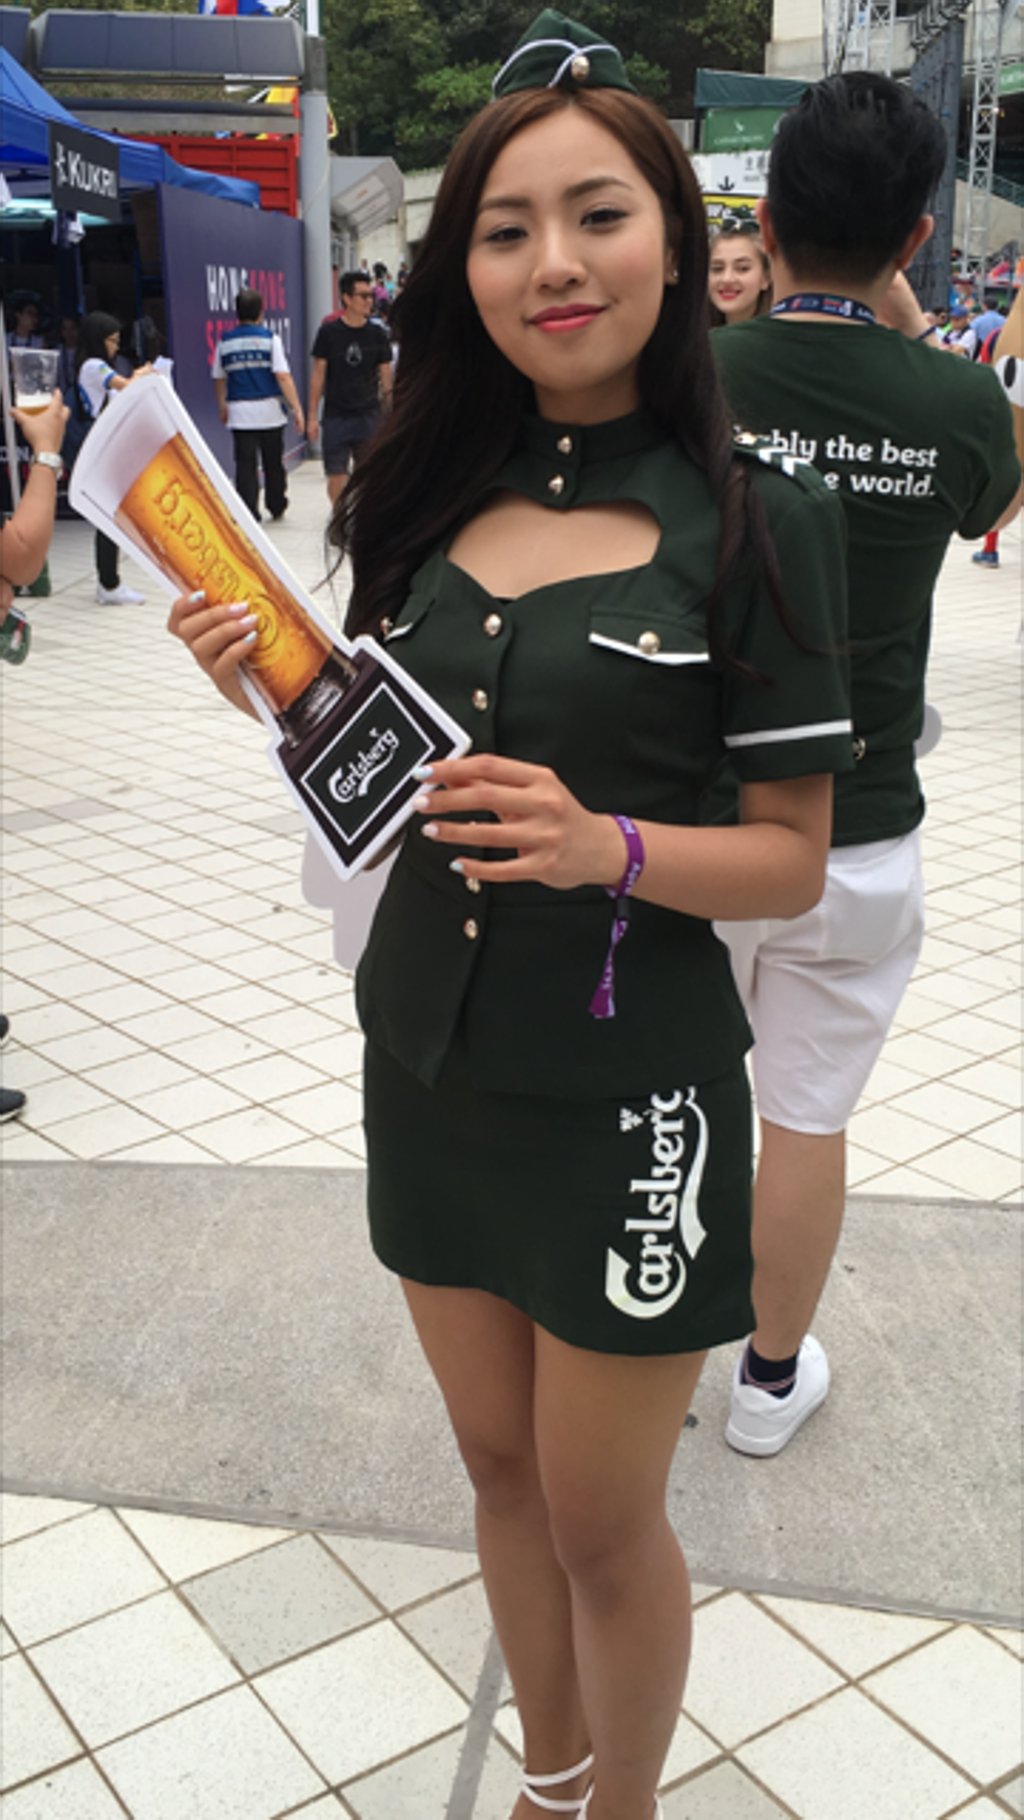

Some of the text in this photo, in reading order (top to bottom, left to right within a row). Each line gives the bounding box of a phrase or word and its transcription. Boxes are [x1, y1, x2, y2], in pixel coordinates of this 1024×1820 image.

[825, 435, 873, 462] the
[881, 438, 938, 467] best
[850, 472, 935, 497] world.
[329, 727, 399, 803] Carlsberg
